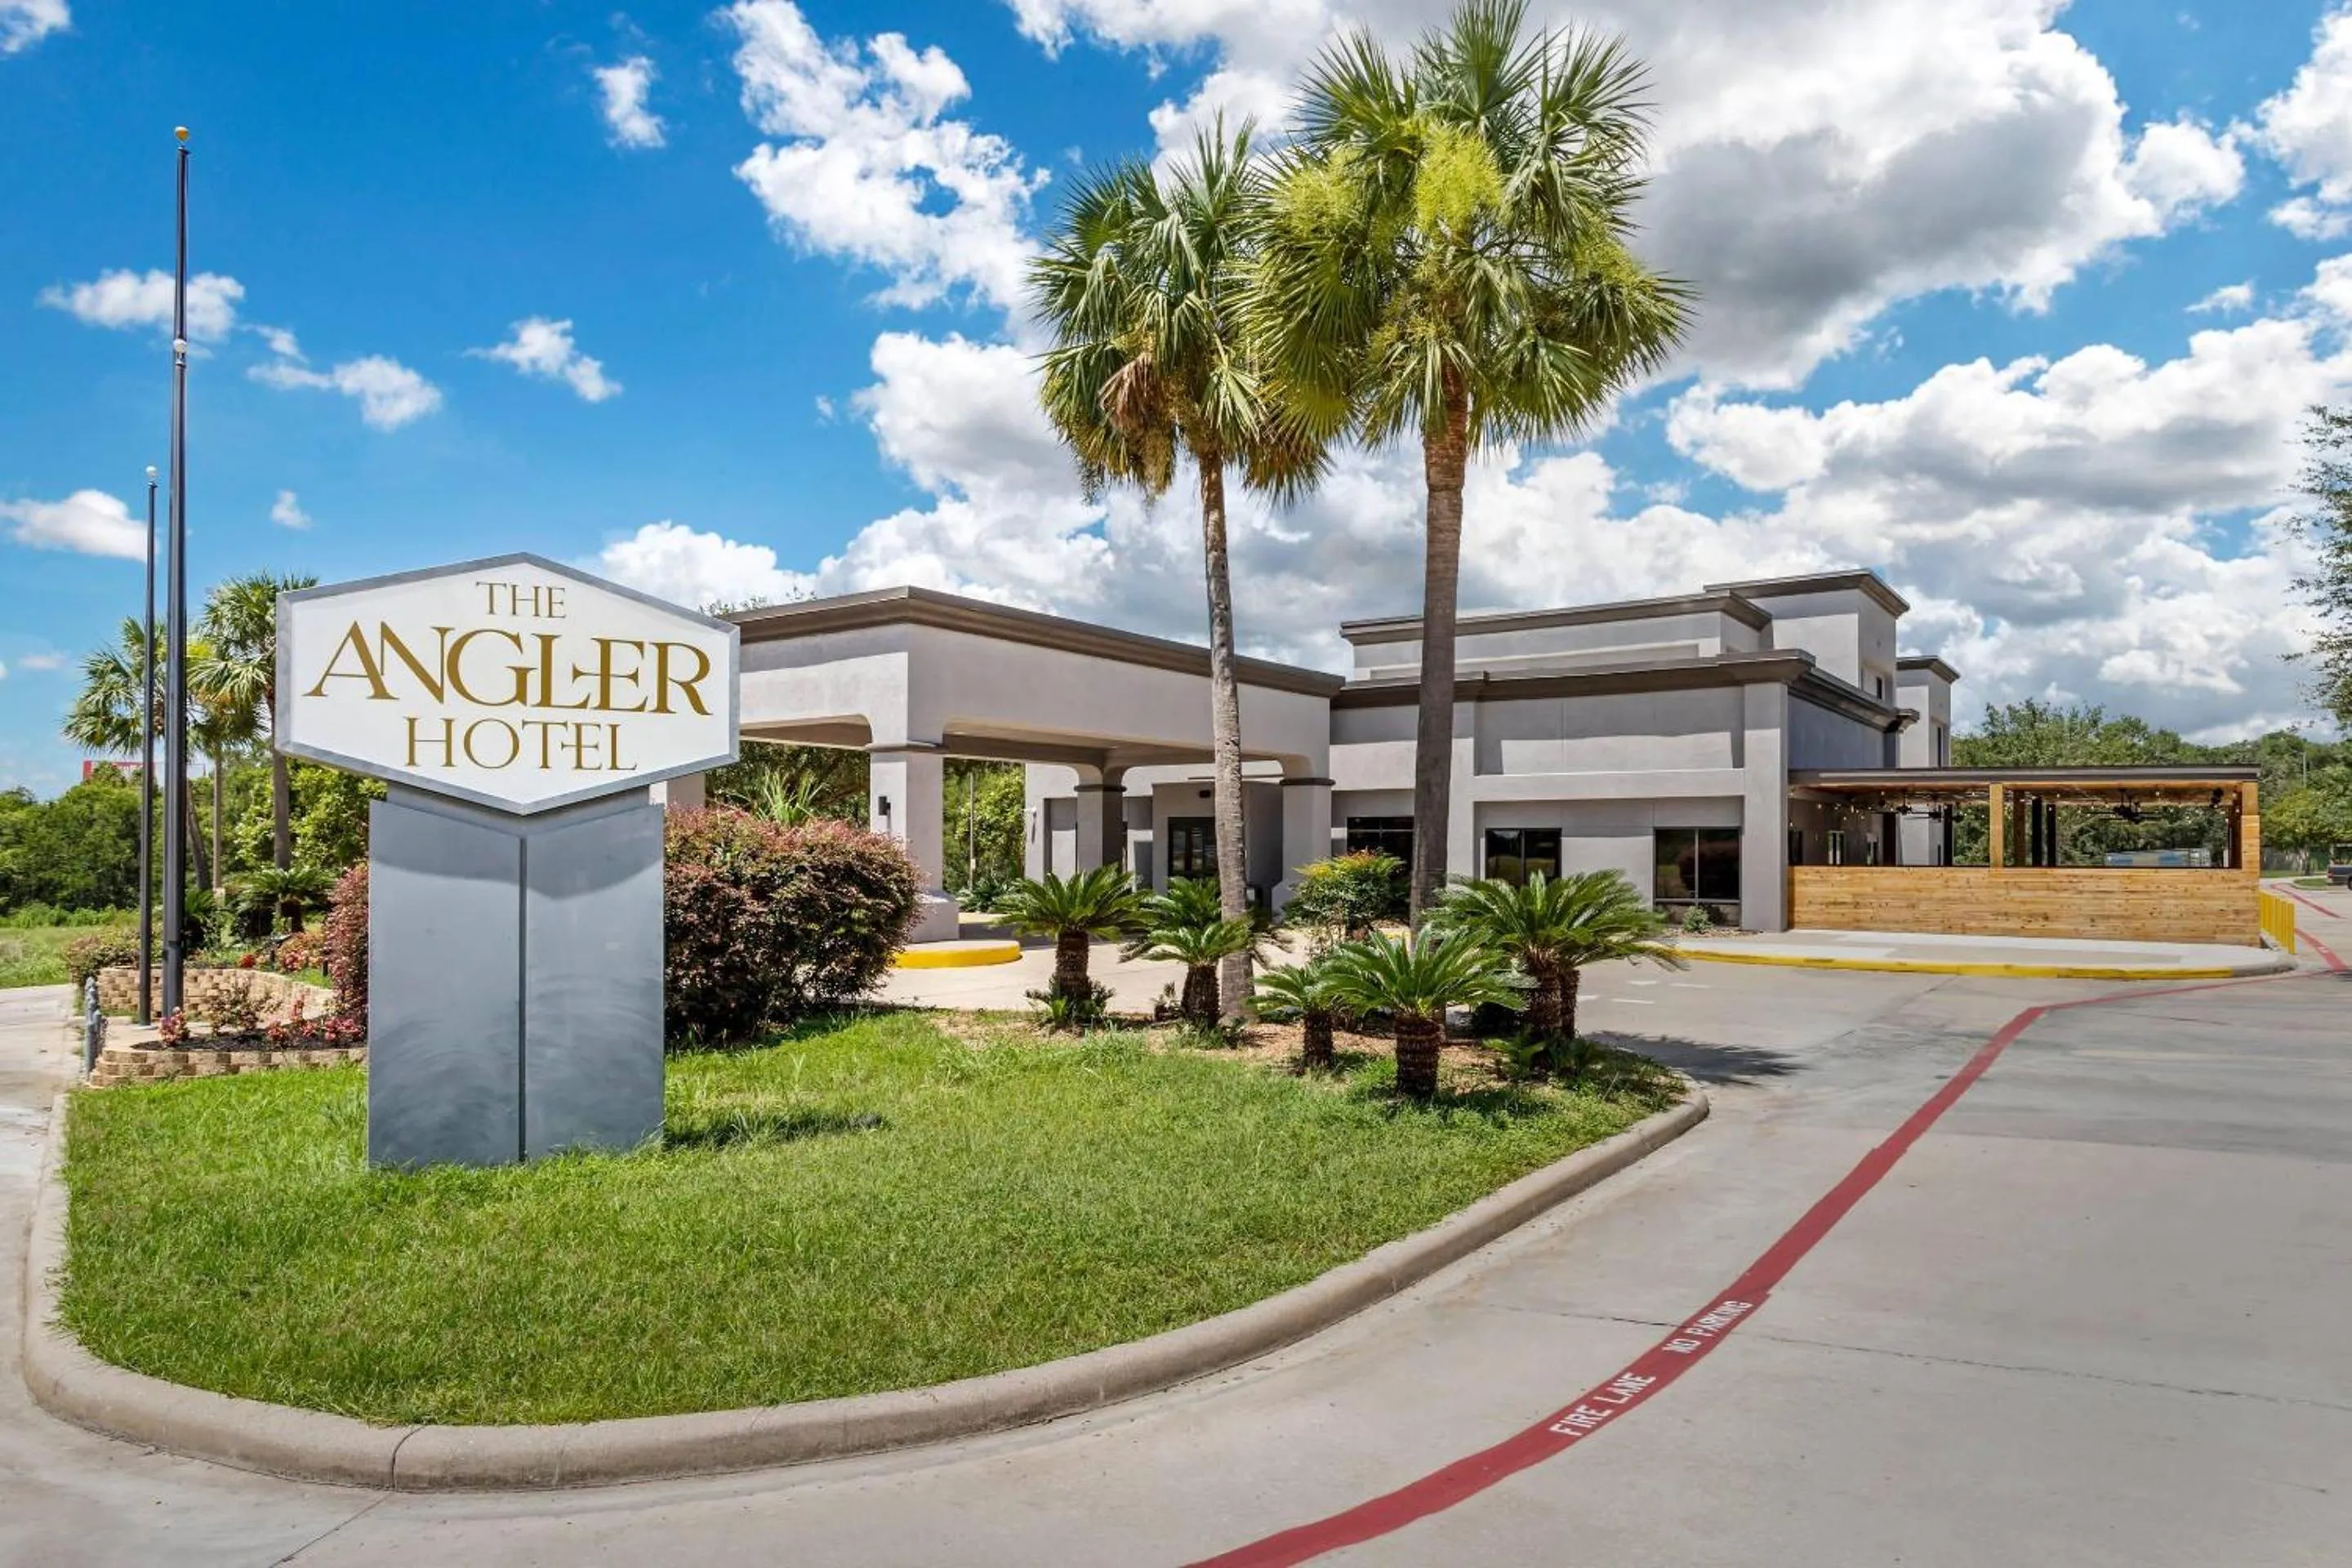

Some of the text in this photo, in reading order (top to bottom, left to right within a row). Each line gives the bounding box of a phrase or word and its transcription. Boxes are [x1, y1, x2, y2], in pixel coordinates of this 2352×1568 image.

[475, 581, 566, 618] THE
[302, 620, 713, 715] ANGLER
[404, 715, 637, 770] HOTEL
[1550, 1300, 1753, 1436] FIRE LANE NO PARKING
